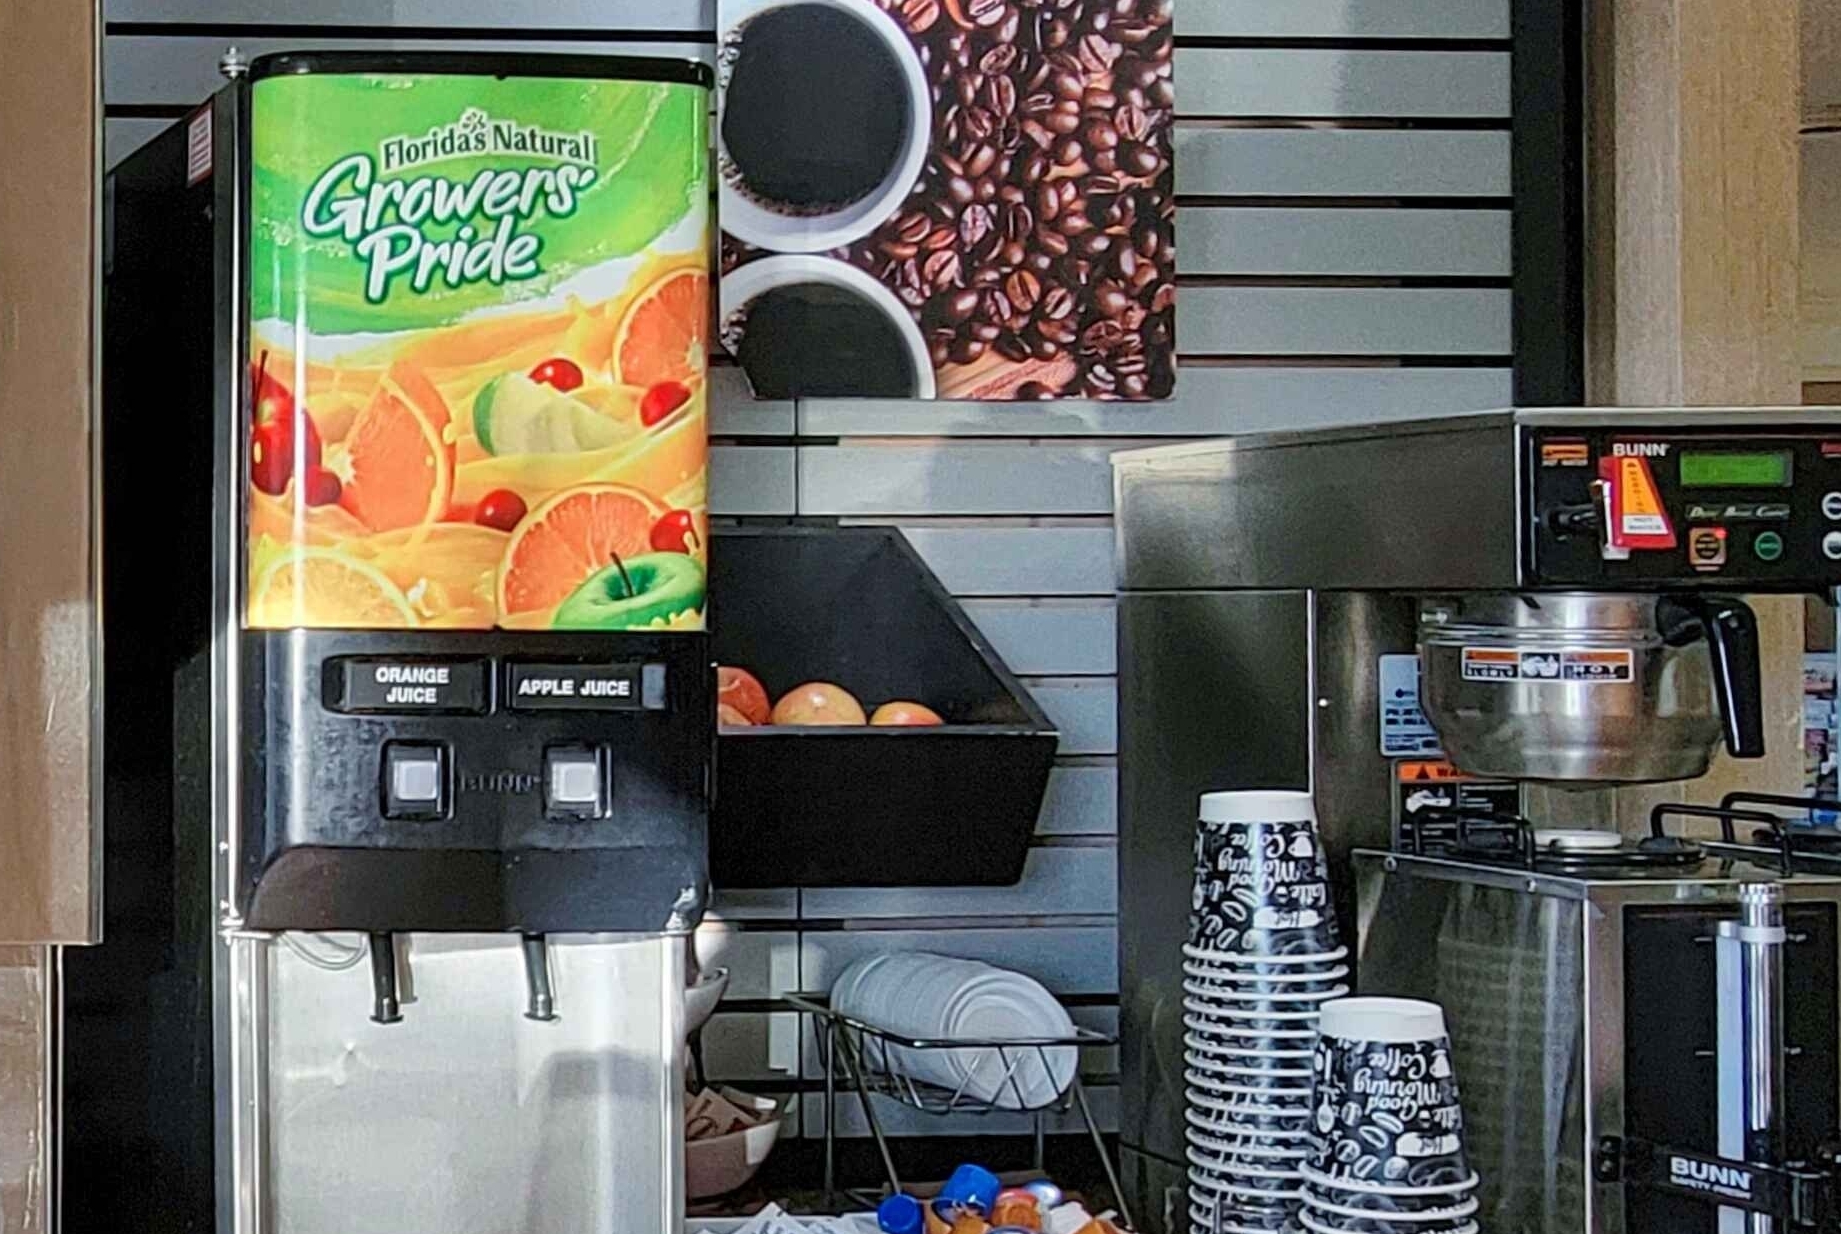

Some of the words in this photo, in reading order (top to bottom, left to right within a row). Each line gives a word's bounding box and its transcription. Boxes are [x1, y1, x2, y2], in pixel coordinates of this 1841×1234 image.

[494, 123, 590, 161] Natural
[304, 154, 597, 240] Growers'
[357, 214, 540, 300] Pride
[1612, 443, 1667, 457] BUNN
[375, 667, 449, 684] ORANGE
[519, 679, 574, 696] APPLE
[580, 680, 630, 697] JUICE
[386, 687, 438, 705] JUICE
[1367, 1048, 1427, 1080] Coffee
[1352, 1067, 1441, 1107] Morning
[1364, 1096, 1419, 1122] Good
[1670, 1156, 1751, 1190] BUNN
